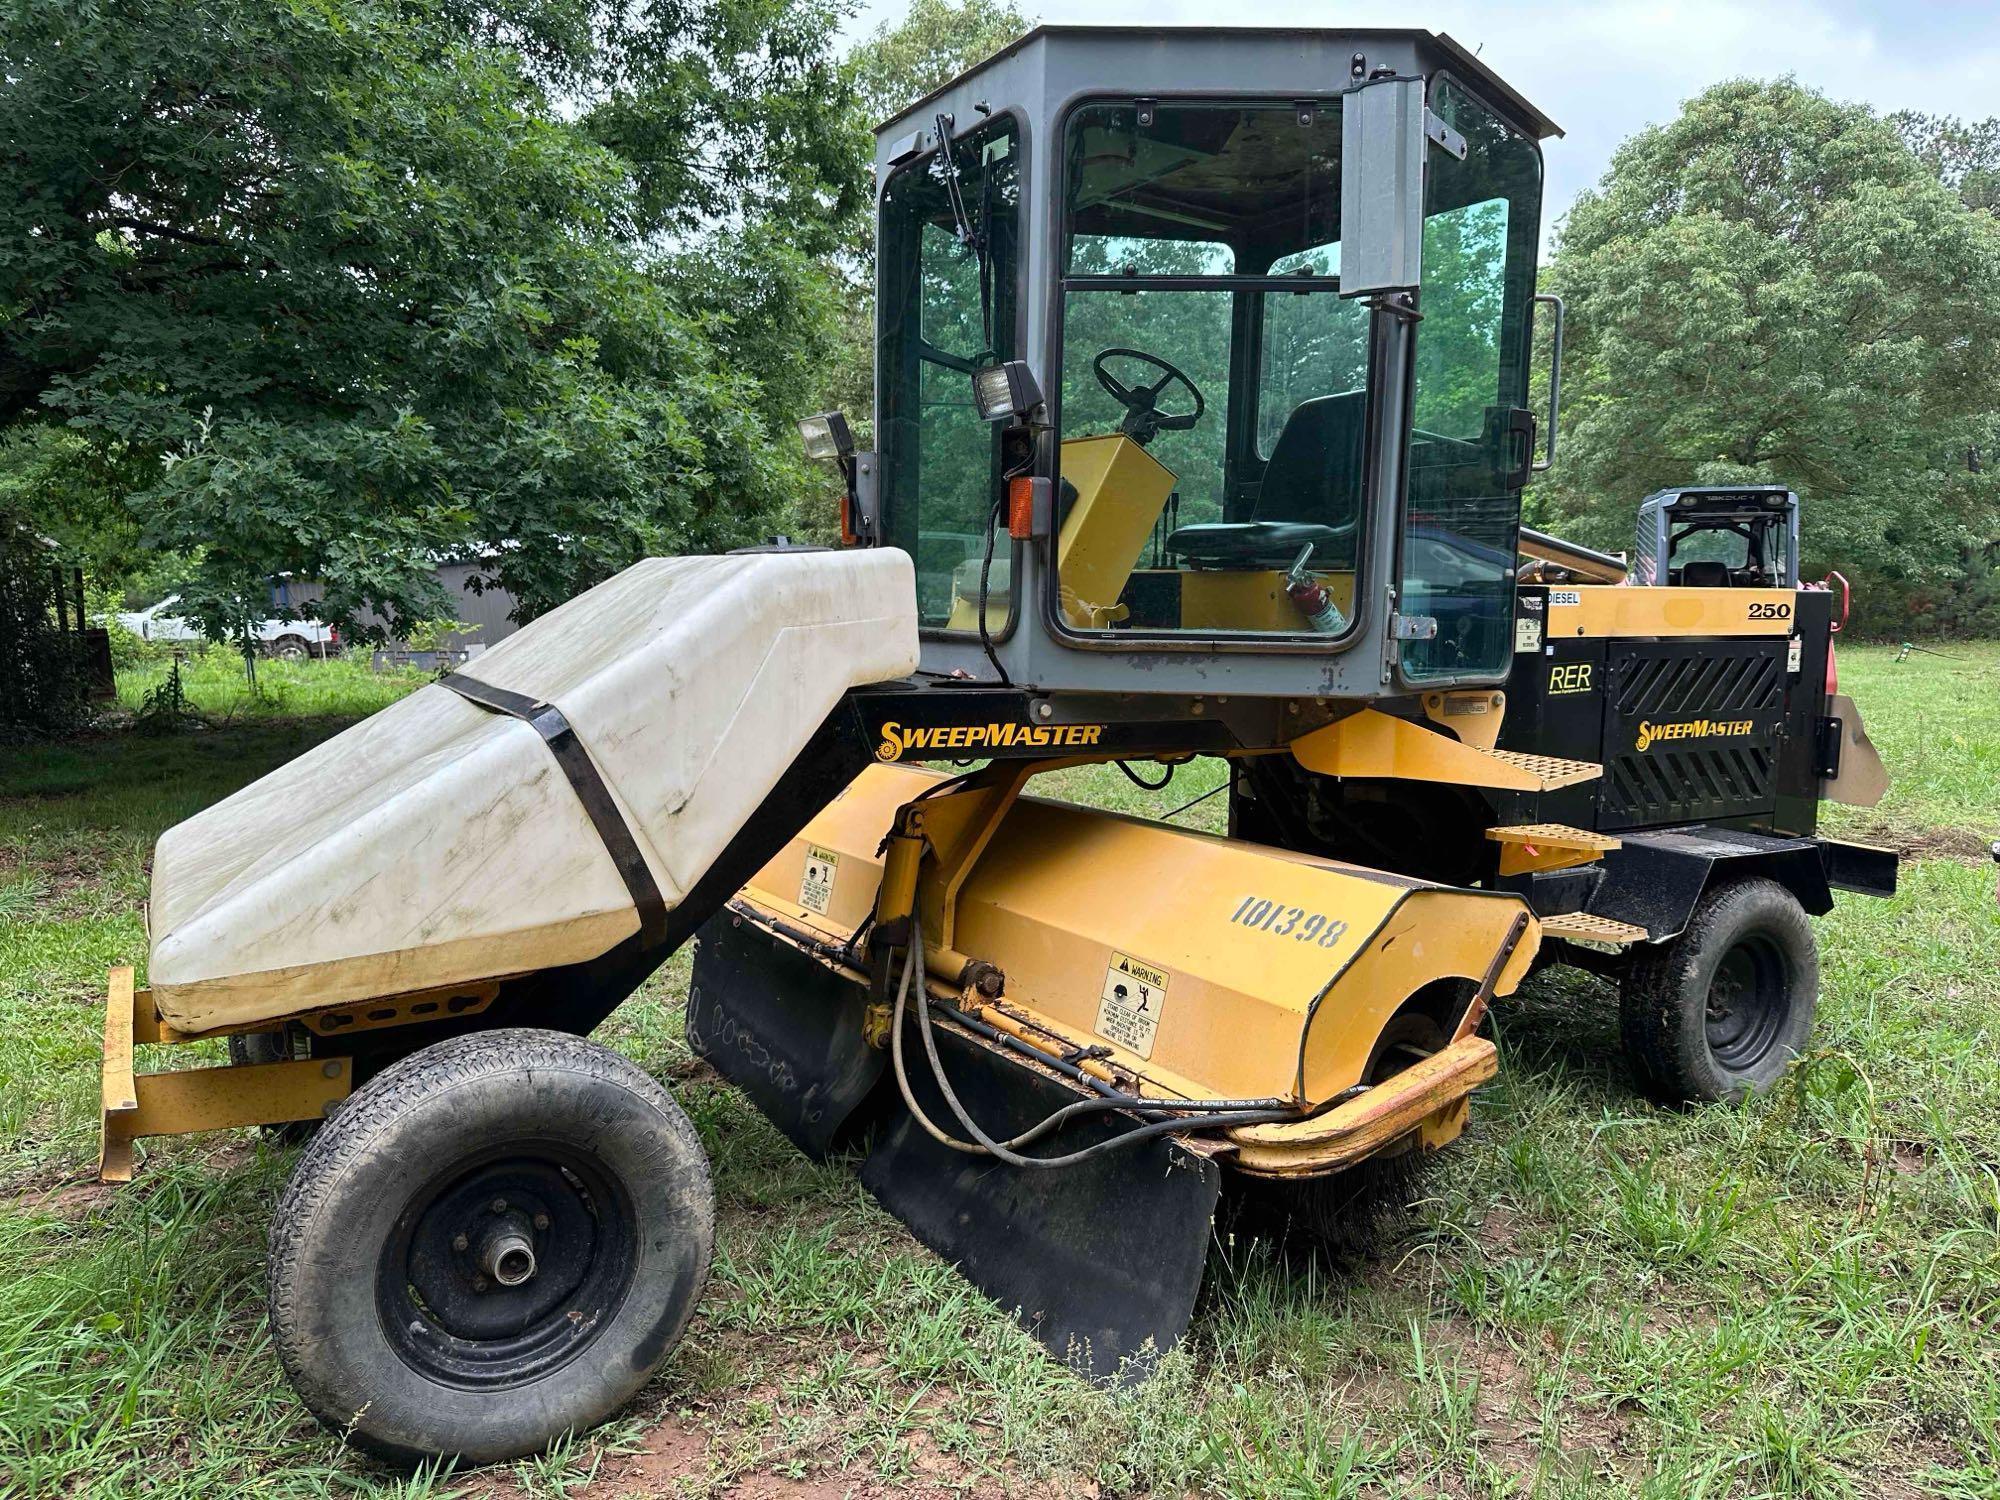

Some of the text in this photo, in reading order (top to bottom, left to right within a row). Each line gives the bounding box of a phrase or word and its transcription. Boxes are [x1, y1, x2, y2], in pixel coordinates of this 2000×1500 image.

[1547, 593, 1578, 604] DIESEL
[1748, 603, 1791, 618] 250
[1549, 664, 1592, 690] RER
[1230, 896, 1348, 948] 101398
[1131, 965, 1162, 986] WARNING
[1120, 1008, 1131, 1018] CLEAR
